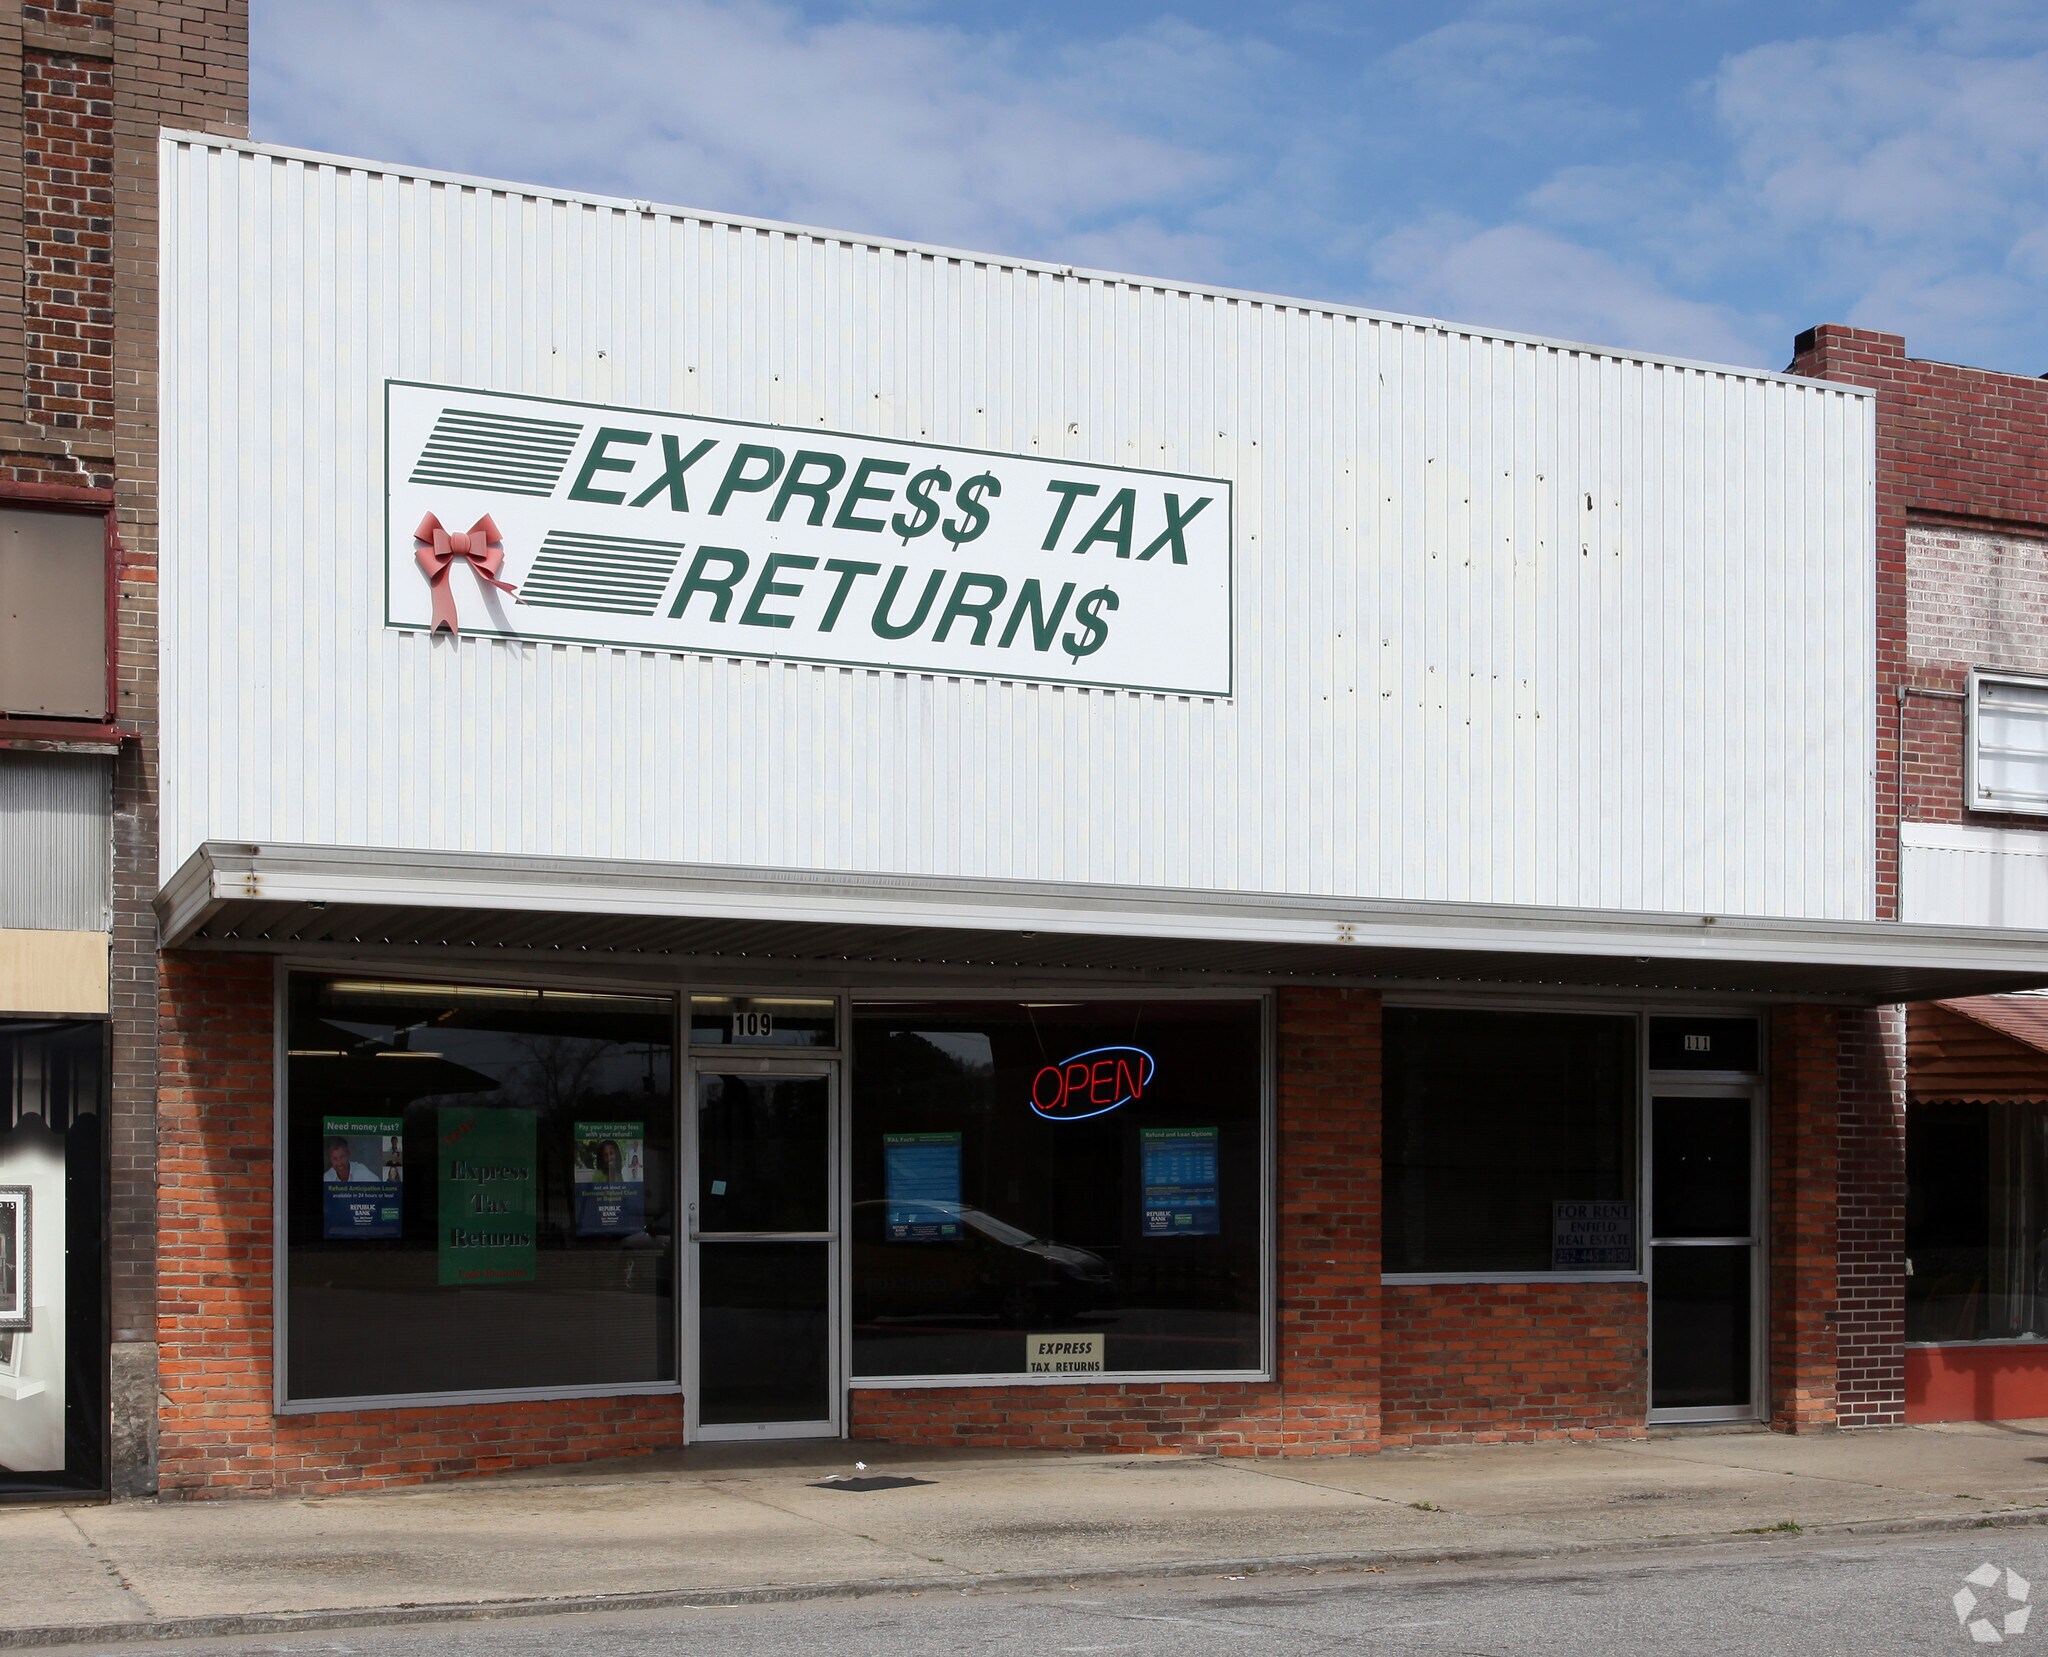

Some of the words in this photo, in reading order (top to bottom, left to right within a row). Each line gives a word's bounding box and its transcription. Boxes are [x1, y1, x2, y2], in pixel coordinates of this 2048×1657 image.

[567, 427, 1001, 552] EXPRE$$
[1039, 480, 1213, 566] TAX
[667, 547, 1119, 665] RETURN$
[735, 1013, 771, 1036] 109
[1686, 1036, 1708, 1049] 111
[1032, 1057, 1146, 1109] OPEN
[327, 1122, 349, 1130] Need
[351, 1123, 377, 1132] money
[380, 1122, 400, 1131] fast?
[450, 1160, 529, 1186] Express
[471, 1193, 511, 1214] Tax
[1557, 1205, 1587, 1218] FOR
[1593, 1205, 1630, 1218] RENT
[1571, 1222, 1617, 1232] ENFIELD
[450, 1228, 530, 1249] Returns
[1558, 1234, 1586, 1245] REAL
[1590, 1234, 1629, 1245] ESTATE
[1038, 1342, 1092, 1355] EXPRESS
[1031, 1362, 1051, 1372] TAX
[1056, 1361, 1100, 1372] RETURNS
